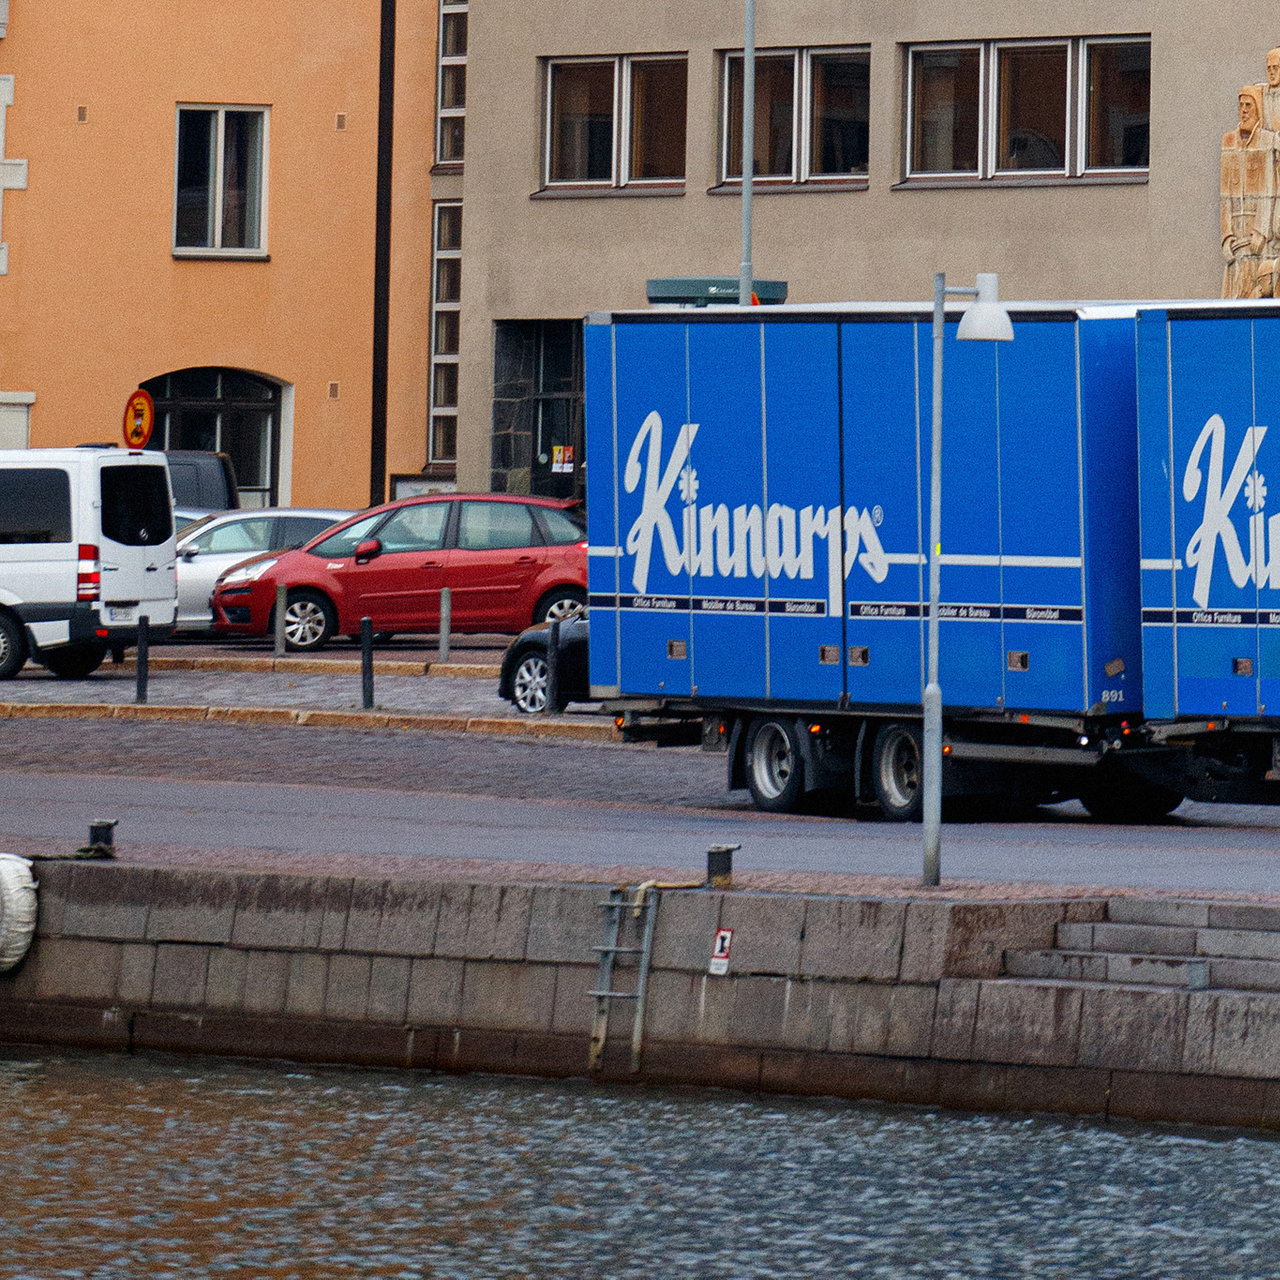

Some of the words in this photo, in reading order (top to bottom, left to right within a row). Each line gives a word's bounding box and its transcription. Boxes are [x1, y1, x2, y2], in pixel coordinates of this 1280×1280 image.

[632, 596, 651, 609] Office
[650, 597, 676, 610] Furniture
[702, 598, 725, 611] Mobilier
[725, 600, 734, 611] de
[735, 600, 756, 612] Bureau
[860, 604, 879, 616] Office
[880, 604, 906, 617] Furniture
[938, 605, 957, 618] obilier
[958, 606, 967, 618] de
[968, 606, 990, 619] Bureau
[1192, 612, 1212, 623] Office
[1213, 612, 1241, 624] Furniture
[1101, 689, 1125, 703] 891
